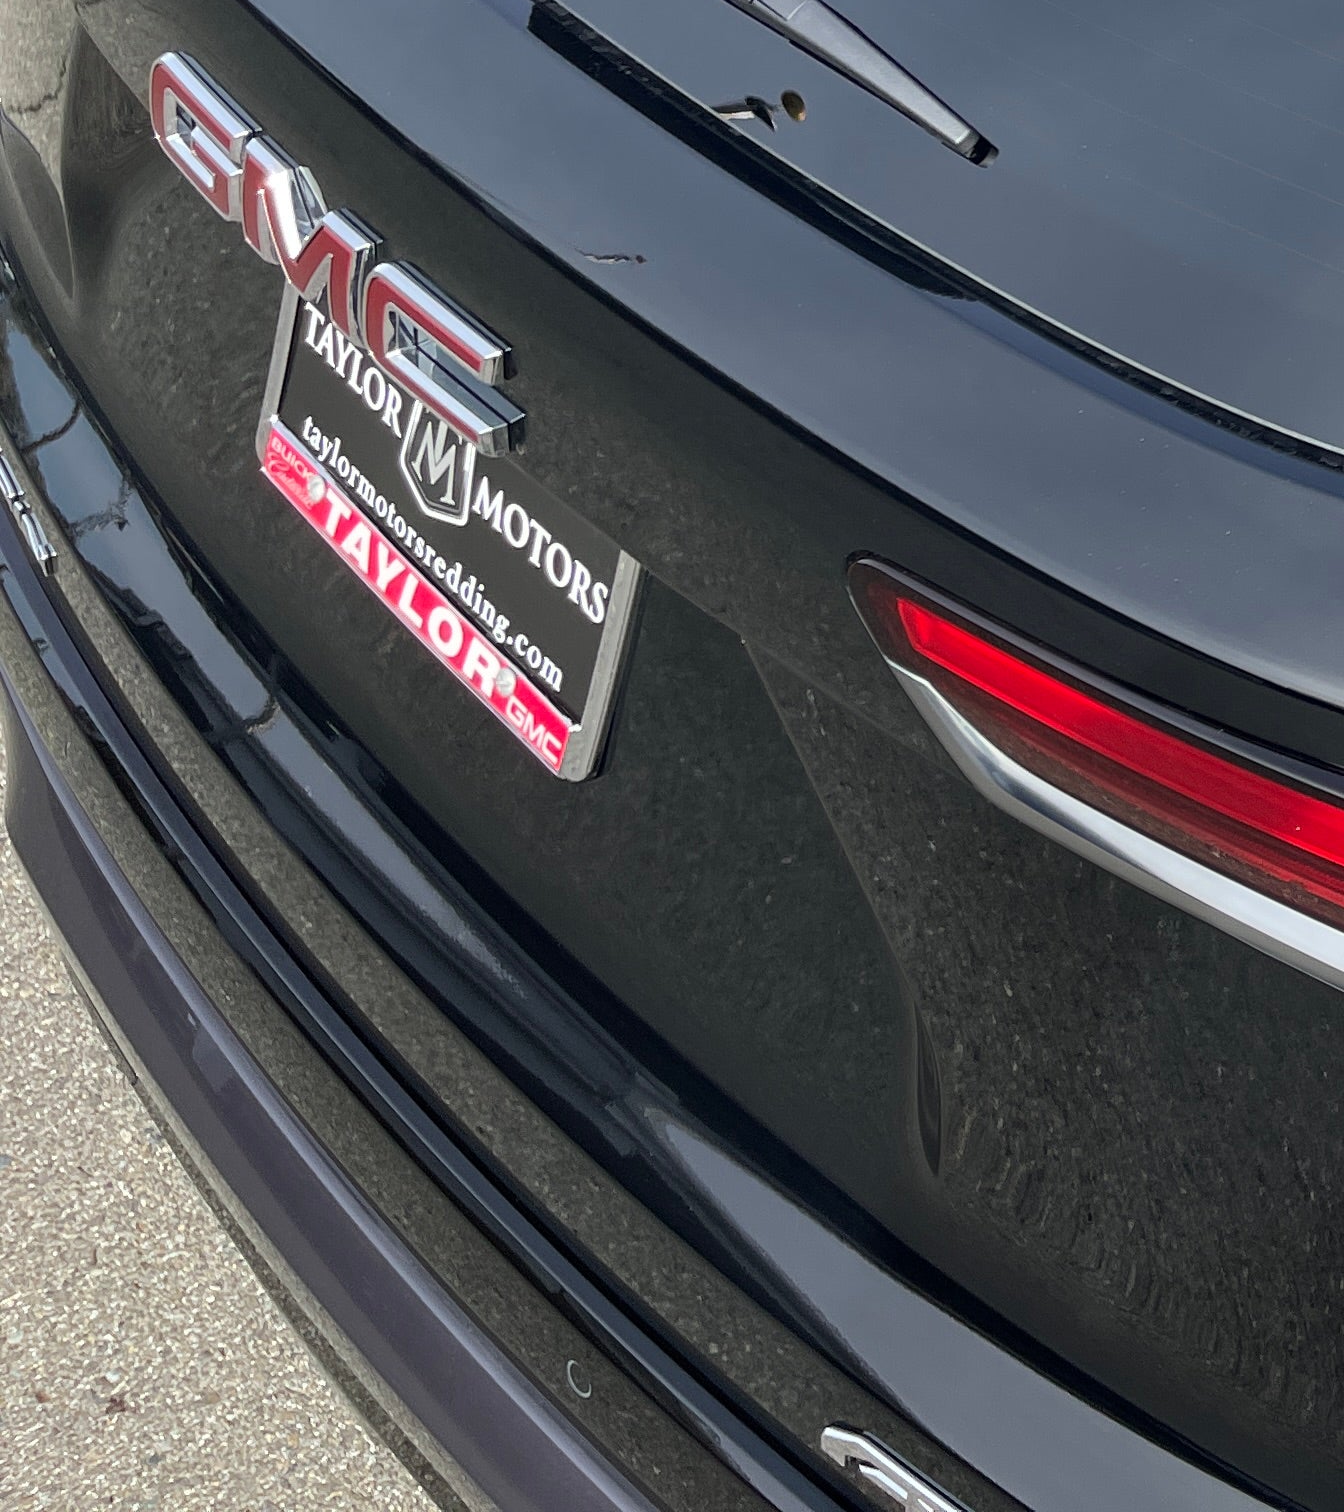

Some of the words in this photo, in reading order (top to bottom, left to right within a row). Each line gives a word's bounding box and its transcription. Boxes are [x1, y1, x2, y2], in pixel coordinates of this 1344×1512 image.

[149, 50, 524, 457] GMC
[270, 436, 319, 480] BUICK
[302, 301, 402, 439] TAYLOR
[472, 475, 609, 624] MOTORS
[302, 415, 565, 694] taylormotorsredding.com
[325, 487, 502, 698] TAYLOR
[506, 698, 563, 766] GMC
